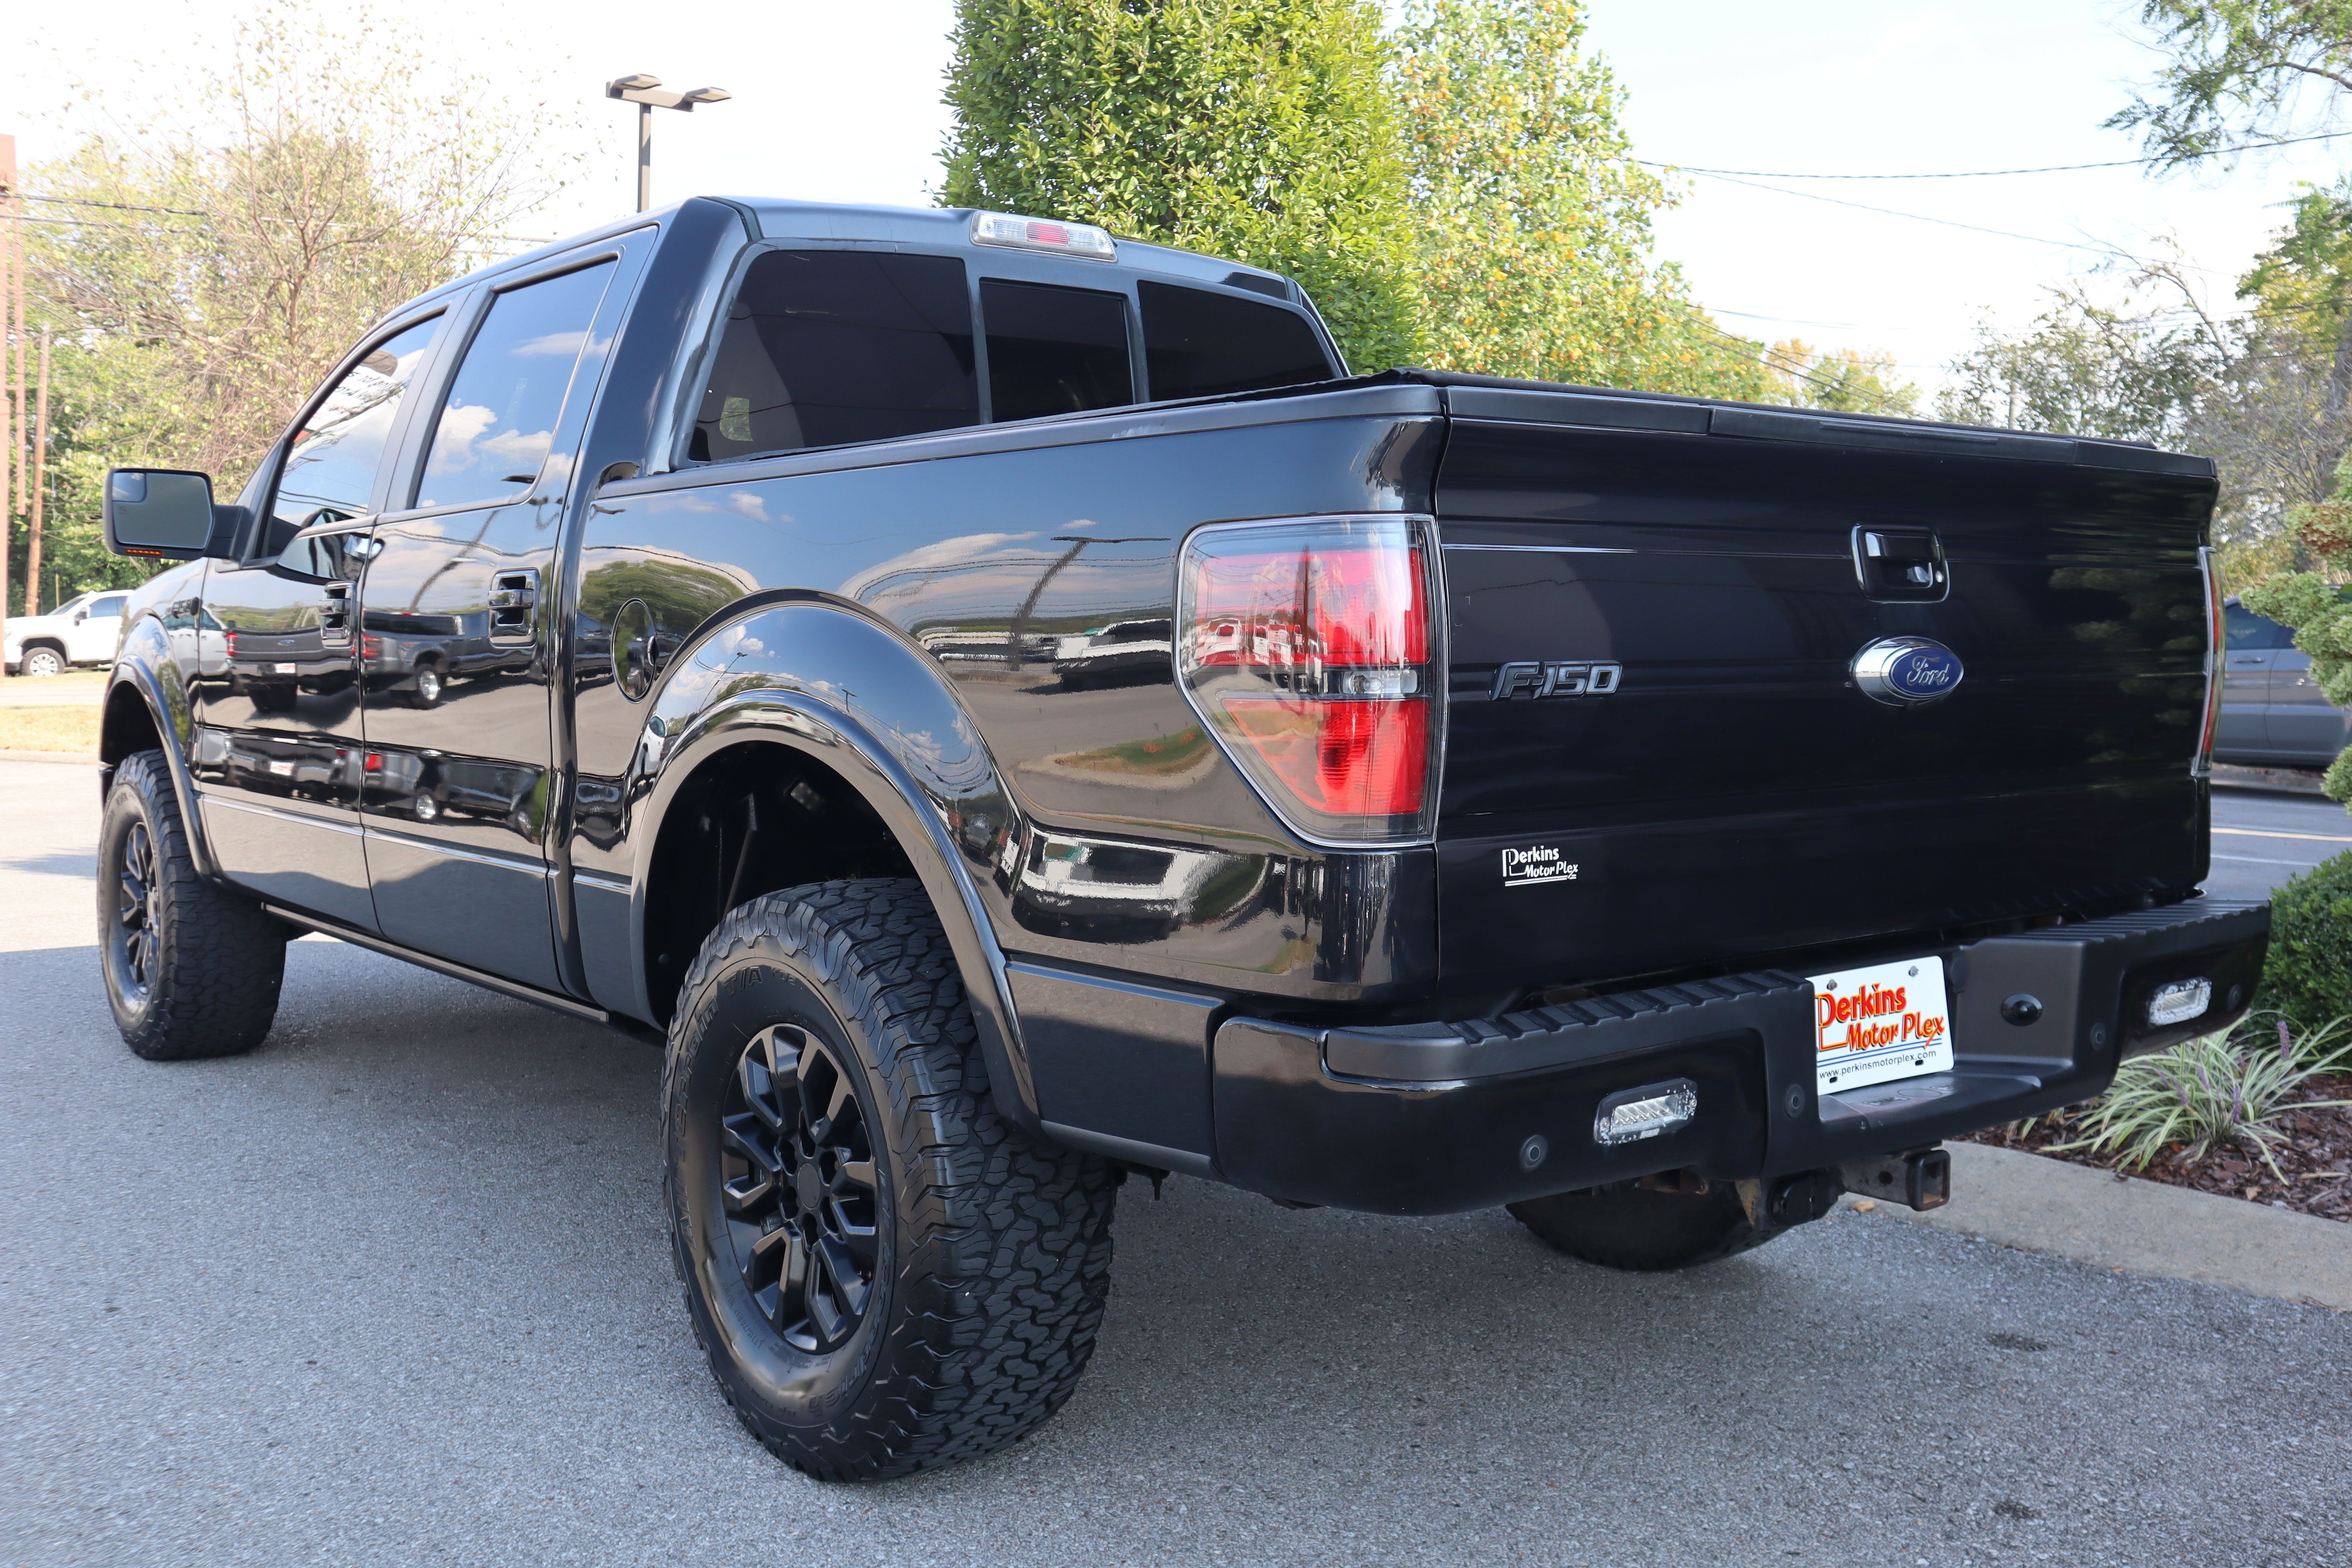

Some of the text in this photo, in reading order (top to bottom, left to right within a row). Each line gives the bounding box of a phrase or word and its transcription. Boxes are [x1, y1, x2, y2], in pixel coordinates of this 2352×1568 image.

[1906, 655, 1951, 686] Ford
[1502, 845, 1559, 877] Perkins
[1815, 982, 1907, 1033] Perkins
[1846, 1011, 1945, 1051] Motor Plex
[1819, 1050, 1937, 1079] www.perkinsmotorplex.com
